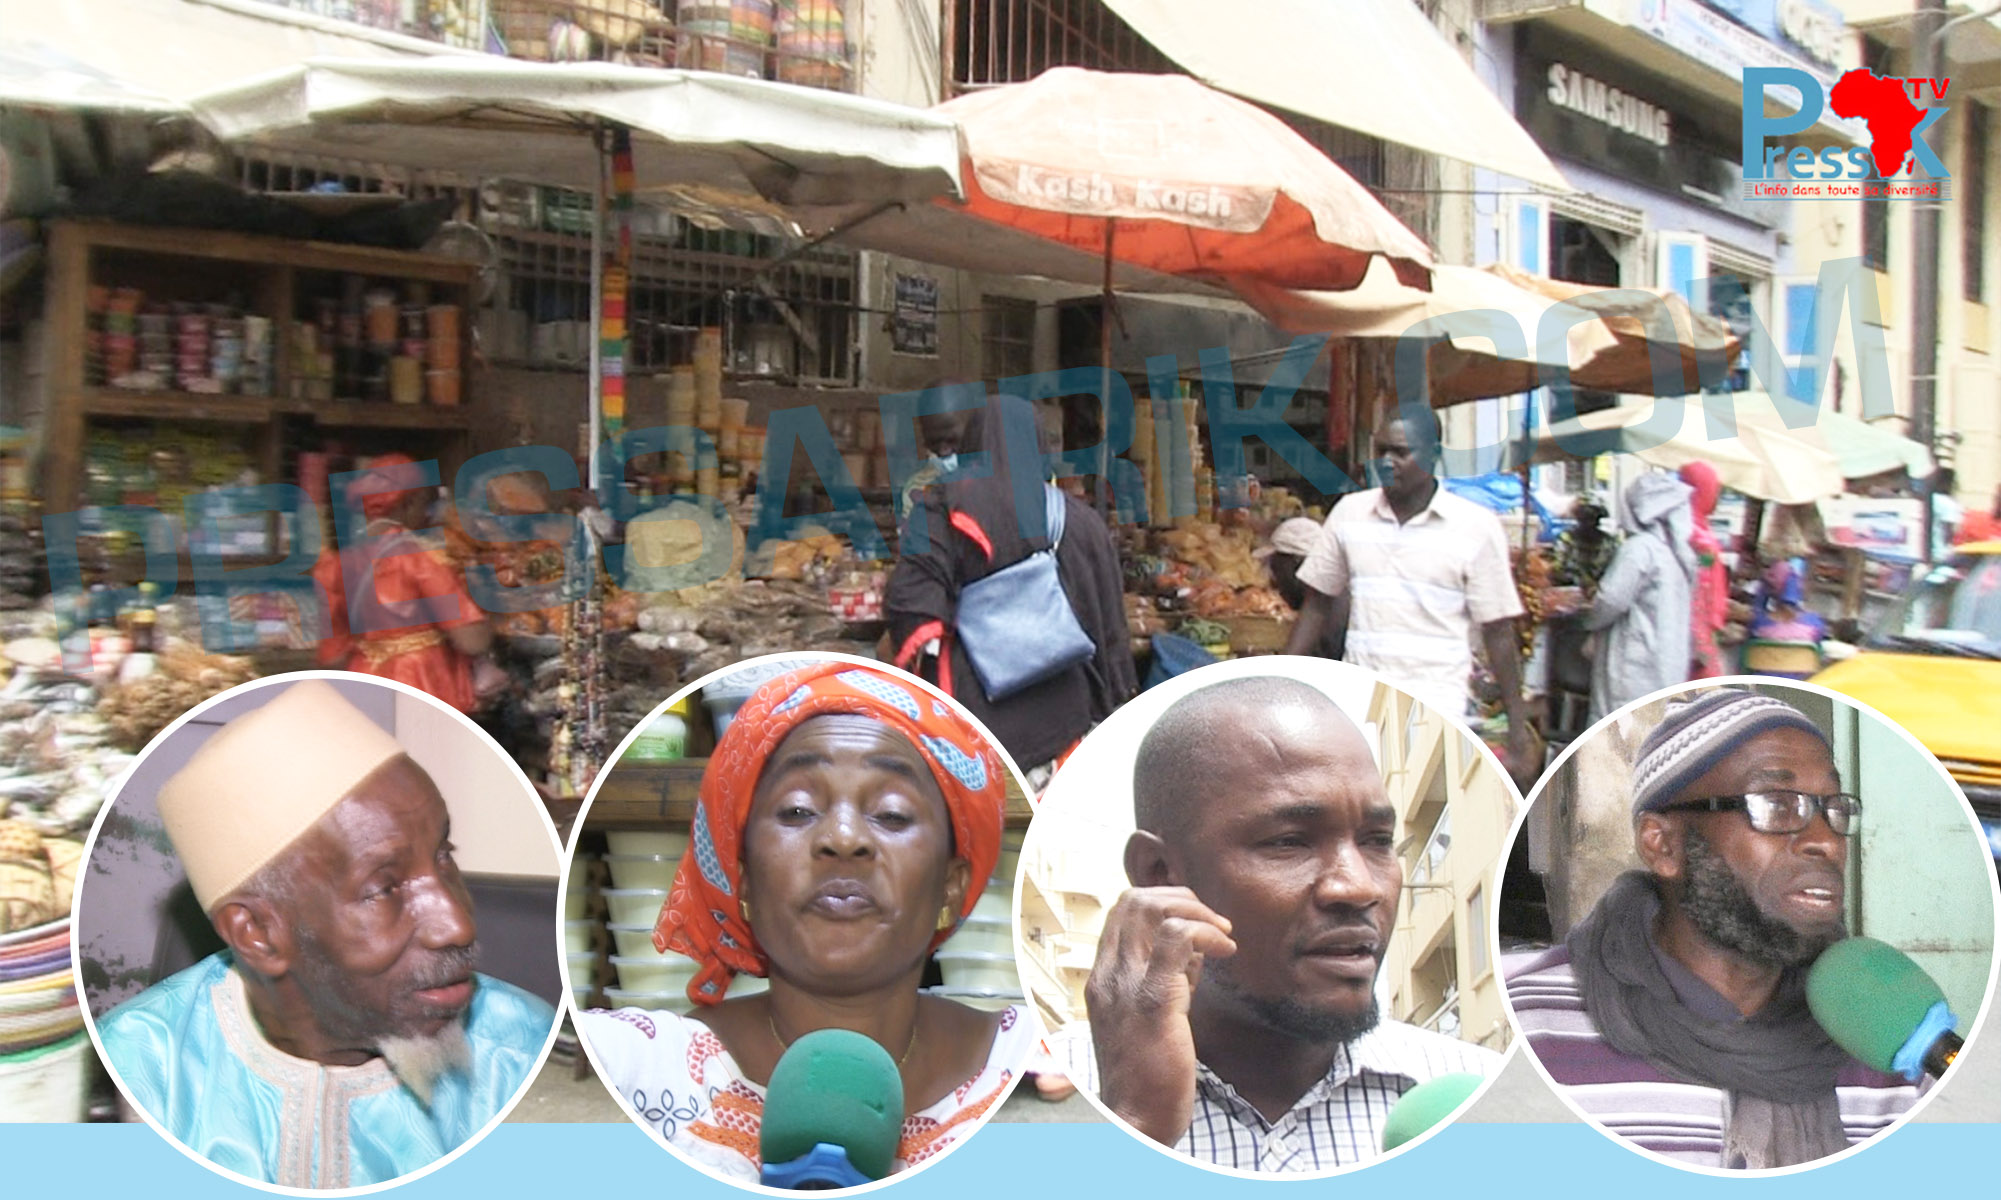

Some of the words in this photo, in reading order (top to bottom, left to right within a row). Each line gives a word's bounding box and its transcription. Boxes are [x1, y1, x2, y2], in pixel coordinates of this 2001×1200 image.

[1547, 62, 1669, 146] SAMSUNG
[1016, 163, 1116, 206] Kash
[1135, 178, 1232, 218] Kash
